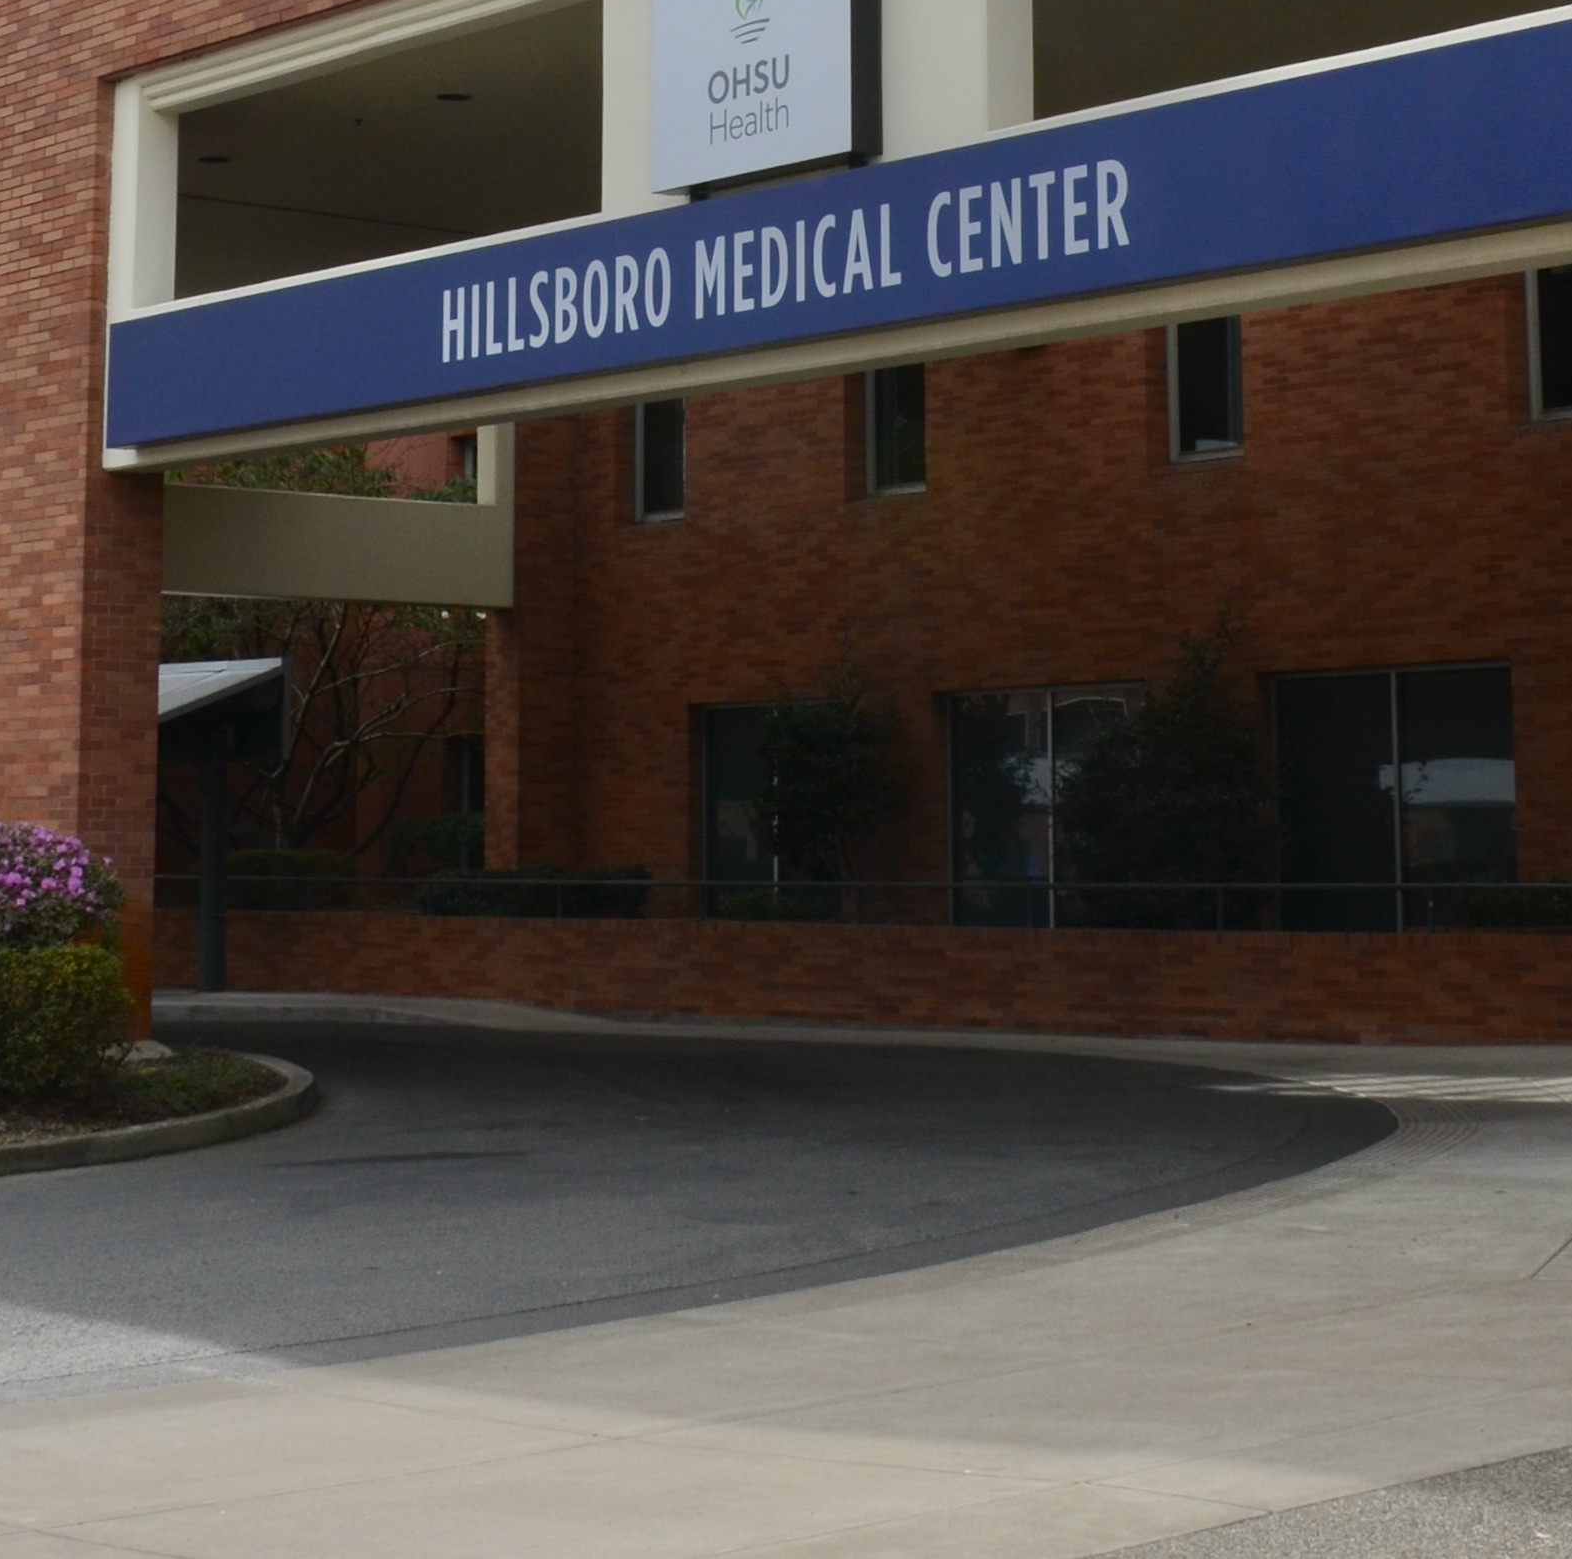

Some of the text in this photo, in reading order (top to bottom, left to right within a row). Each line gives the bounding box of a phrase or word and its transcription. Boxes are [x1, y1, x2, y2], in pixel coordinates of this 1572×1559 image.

[707, 53, 791, 105] OHSU
[708, 97, 790, 145] Health
[441, 158, 1131, 363] HILLSBORO MEDICAL CENTER
